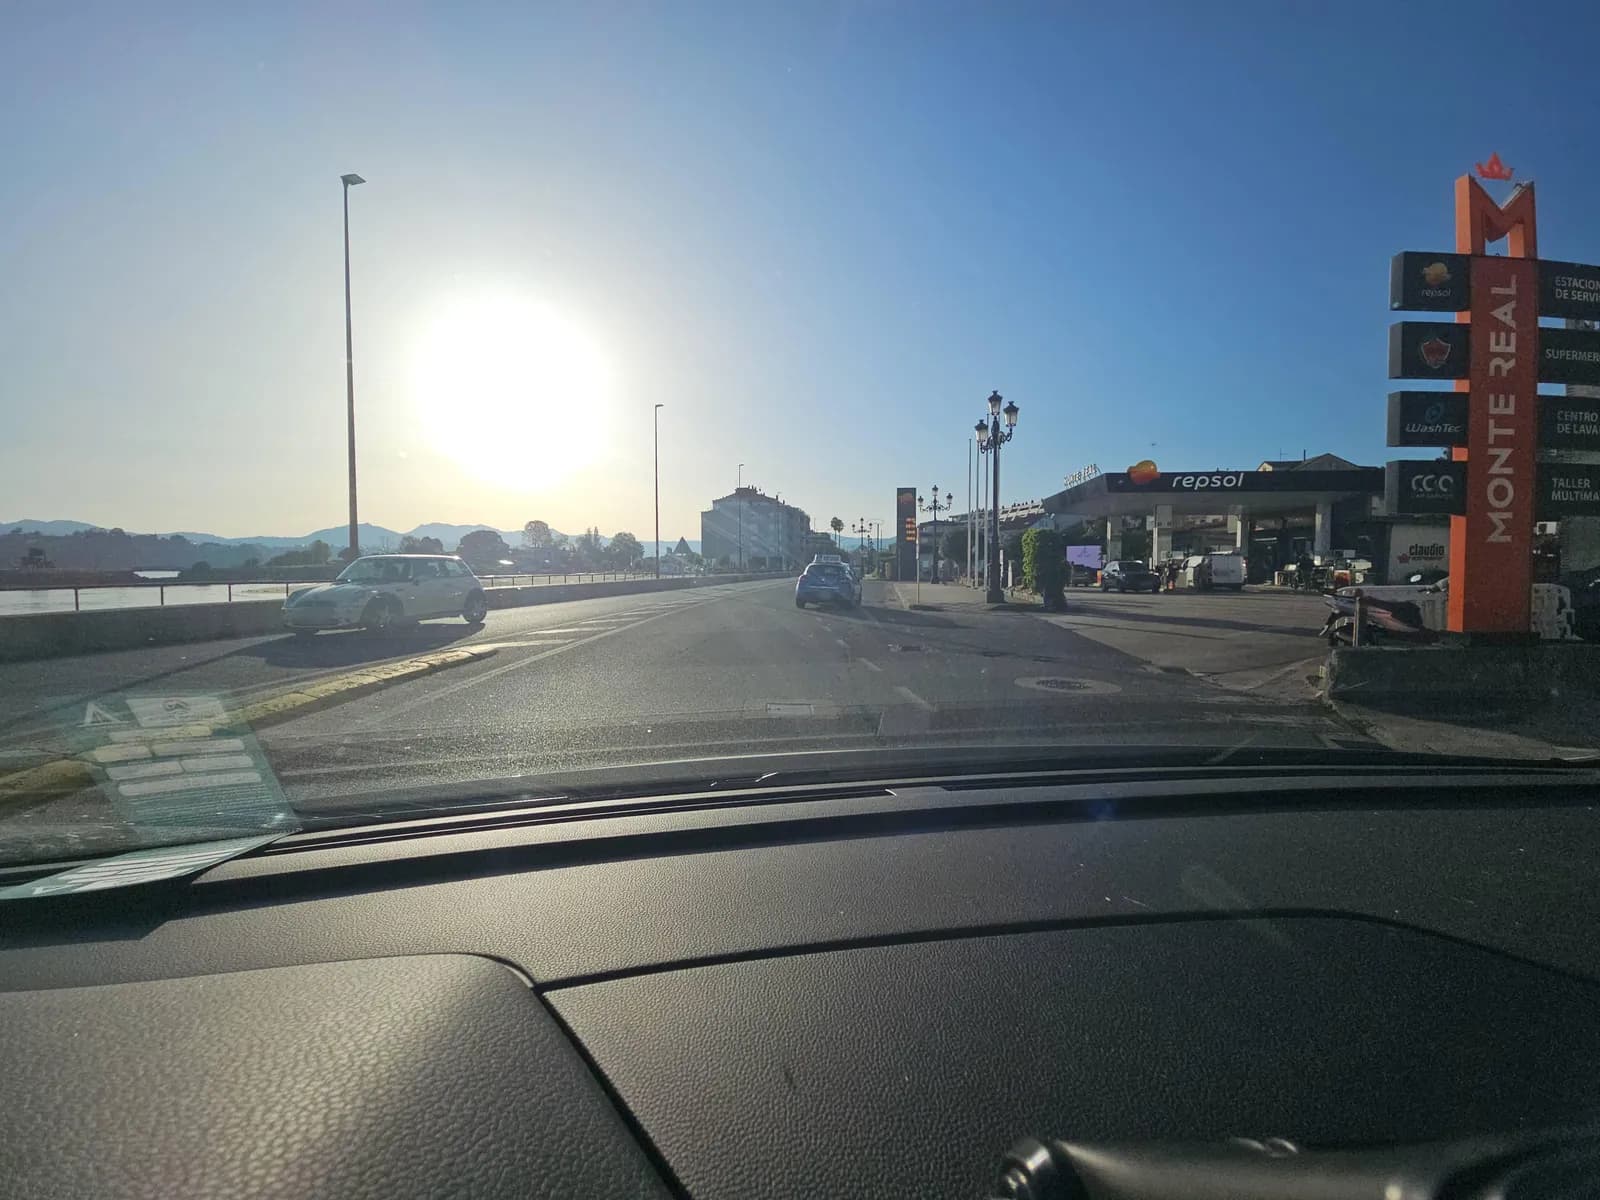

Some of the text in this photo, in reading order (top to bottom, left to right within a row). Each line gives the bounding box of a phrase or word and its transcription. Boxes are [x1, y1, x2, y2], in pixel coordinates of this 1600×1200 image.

[1421, 287, 1452, 298] repsol
[1555, 288, 1600, 303] DE SERVI
[1545, 348, 1600, 362] SUPERMER
[1486, 274, 1517, 543] MONTE REAL
[1557, 410, 1599, 423] CENTRO
[1557, 423, 1600, 436] DE LAVA
[1172, 472, 1245, 491] repsol
[1551, 477, 1591, 489] TALLER
[1551, 489, 1600, 502] MULTIMA
[1409, 543, 1446, 556] claudio
